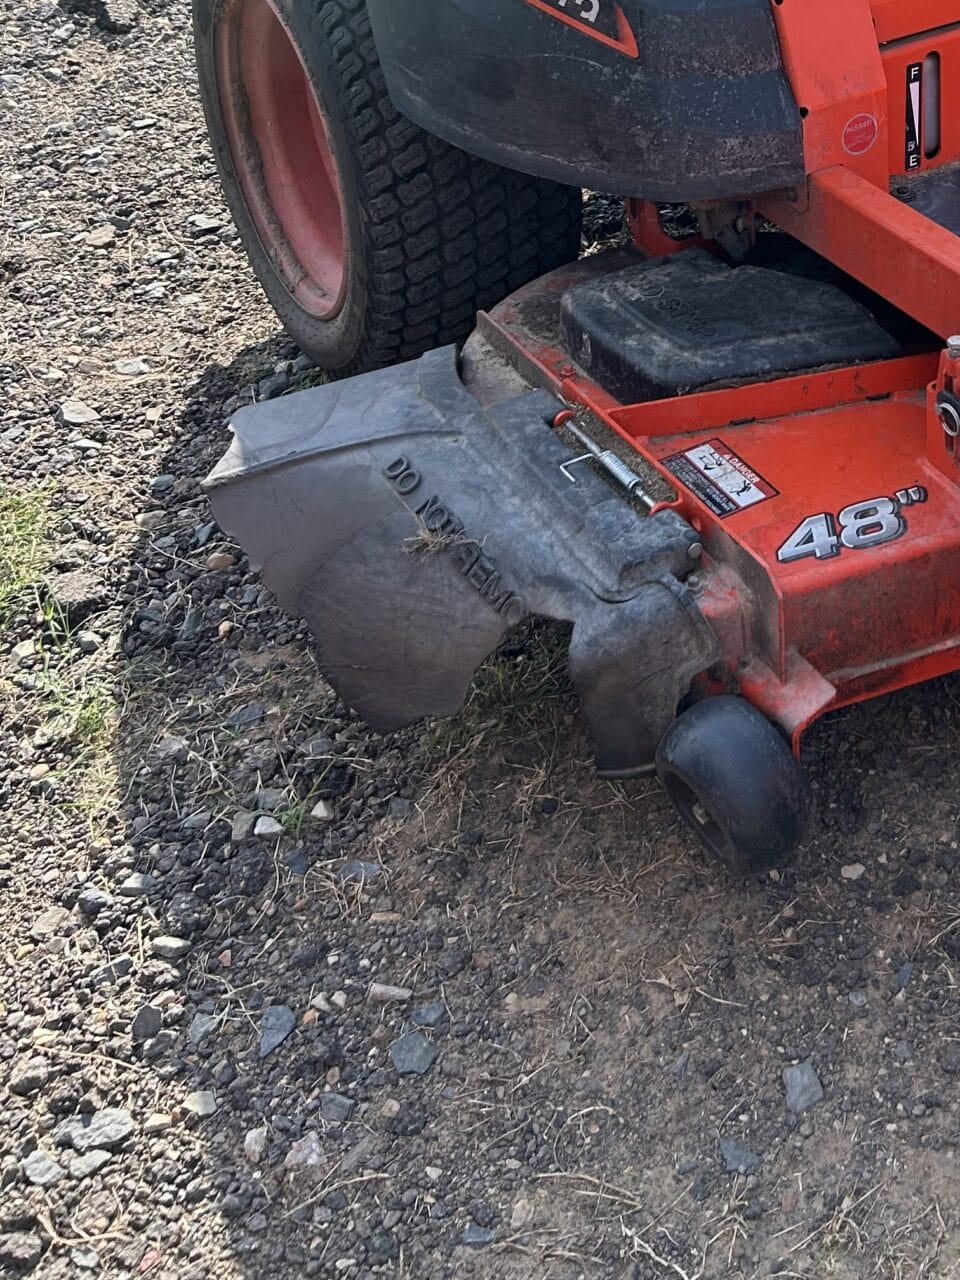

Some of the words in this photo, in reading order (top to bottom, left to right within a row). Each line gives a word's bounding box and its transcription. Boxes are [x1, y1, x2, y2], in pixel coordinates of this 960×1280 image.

[911, 66, 920, 80] F
[909, 154, 918, 167] E
[384, 455, 422, 495] DO
[729, 457, 760, 484] DANGER
